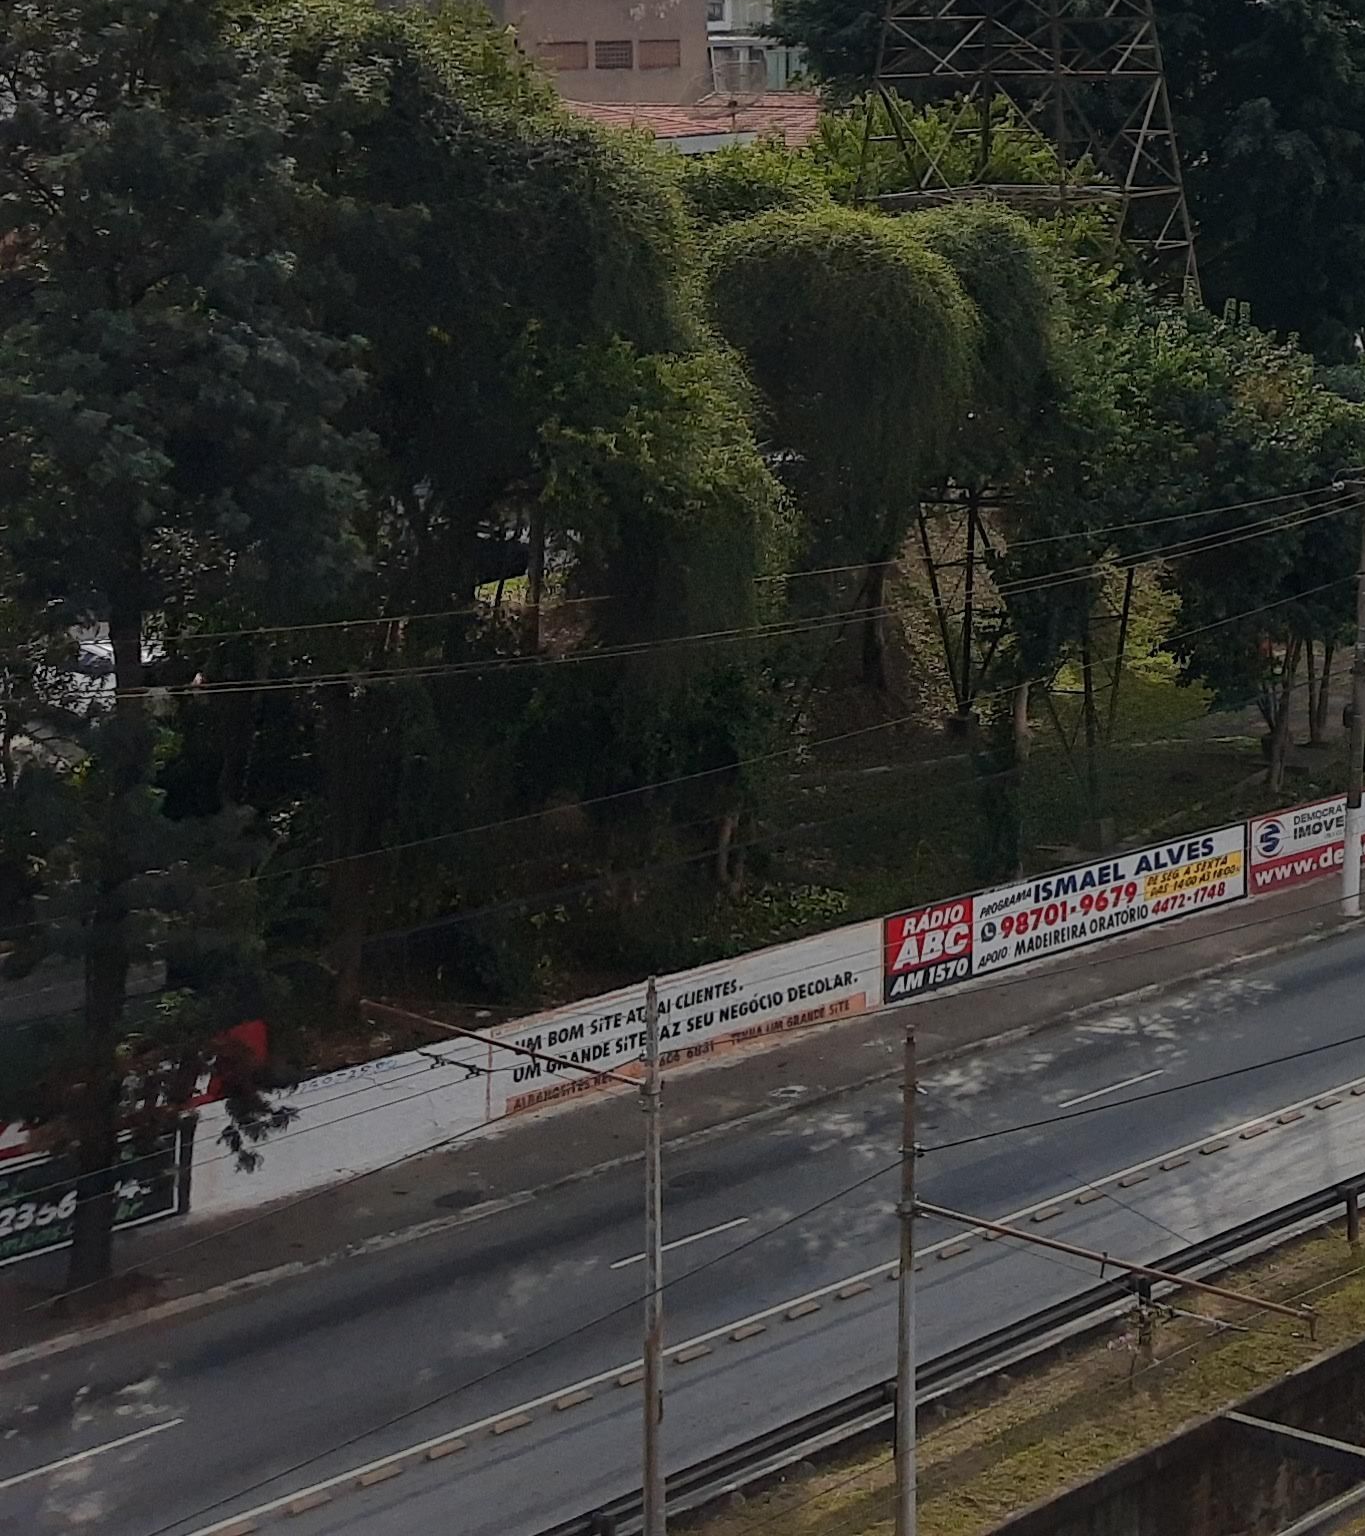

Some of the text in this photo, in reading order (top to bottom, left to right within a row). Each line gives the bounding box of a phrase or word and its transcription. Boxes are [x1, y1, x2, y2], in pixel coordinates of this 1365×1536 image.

[979, 837, 1215, 919] PROGRAMA ISMAEL ALVES
[902, 903, 965, 937] RÁDIO
[1000, 881, 1138, 939] 98701-9679
[1014, 921, 1087, 958] MADEIREIRA
[1089, 904, 1148, 934] ORATÓRIO
[892, 922, 969, 971] ABC
[890, 957, 969, 997] AM 1570
[513, 1062, 542, 1083] UM
[656, 1022, 681, 1041] AZ
[686, 1010, 714, 1033] SEU
[719, 991, 784, 1023] NEGÓCIO
[788, 971, 859, 1003] DECOLAR.
[547, 1023, 584, 1047] BOM
[626, 998, 671, 1026] ATAI
[674, 978, 744, 1010] CLIENTES.
